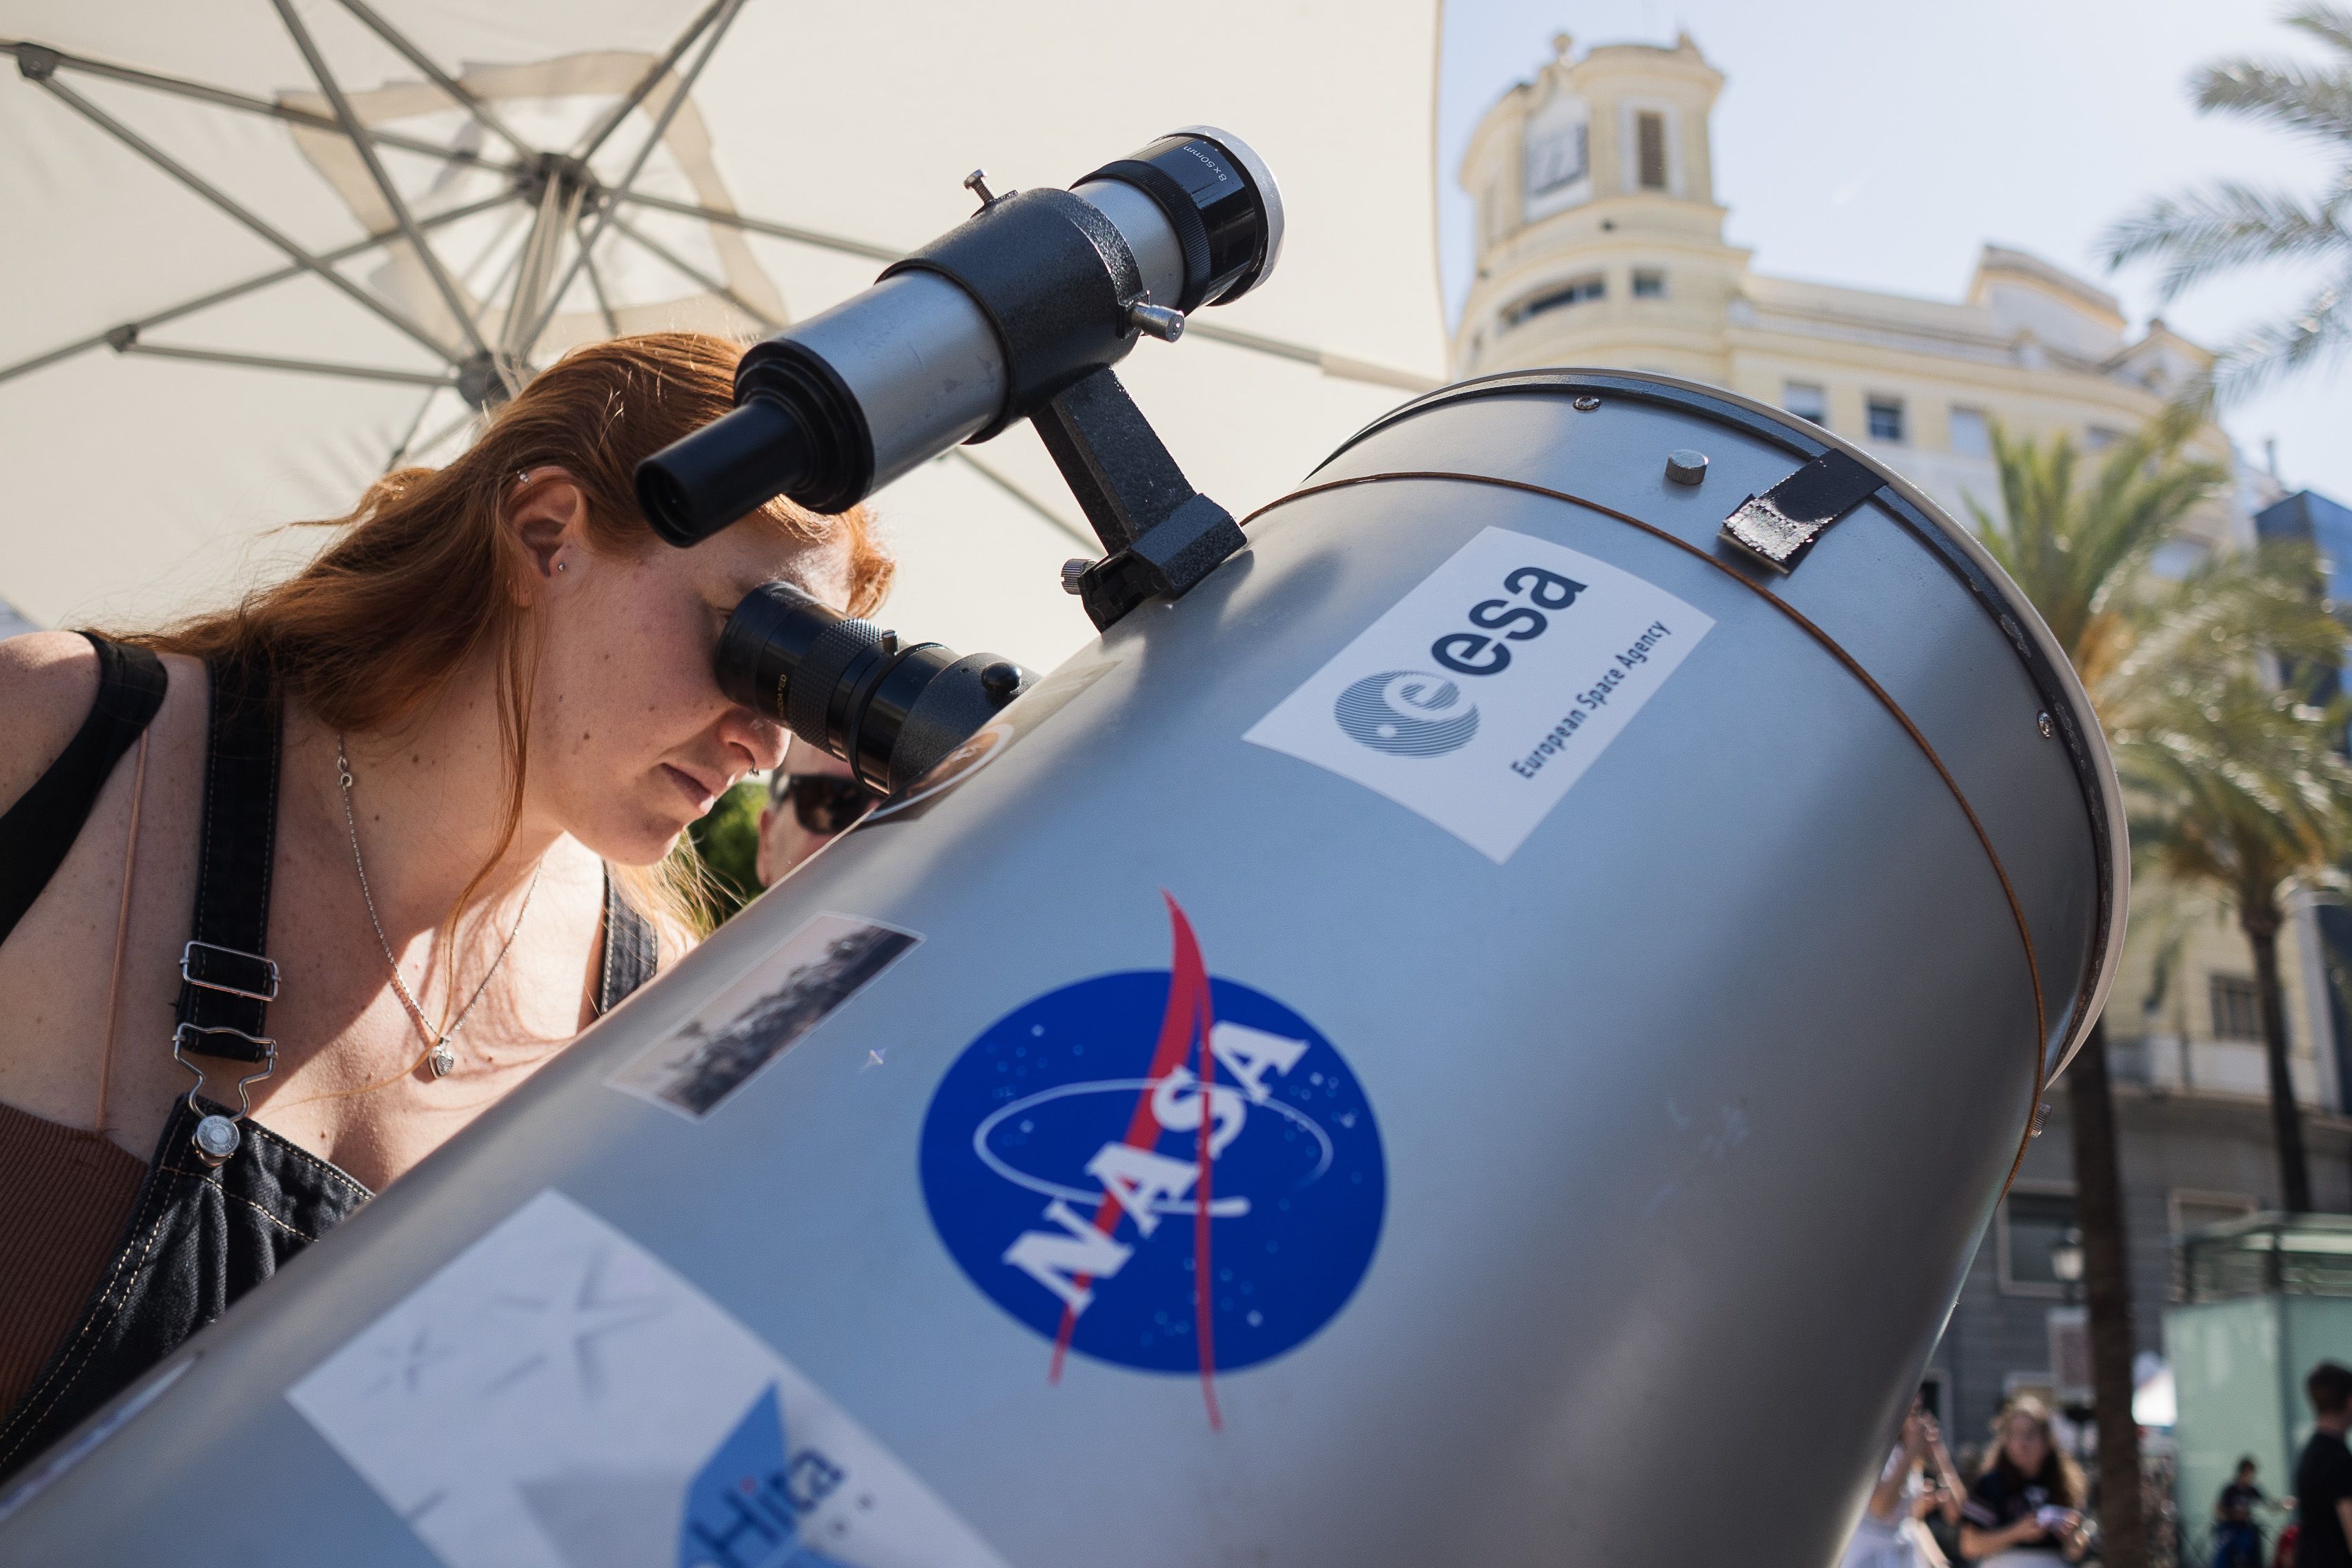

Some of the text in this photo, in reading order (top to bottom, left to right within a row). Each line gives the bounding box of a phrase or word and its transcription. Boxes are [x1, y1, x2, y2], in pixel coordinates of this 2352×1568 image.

[1430, 566, 1589, 677] esa
[1510, 620, 1672, 779] European Space Agency
[1001, 1019, 1311, 1318] NASA
